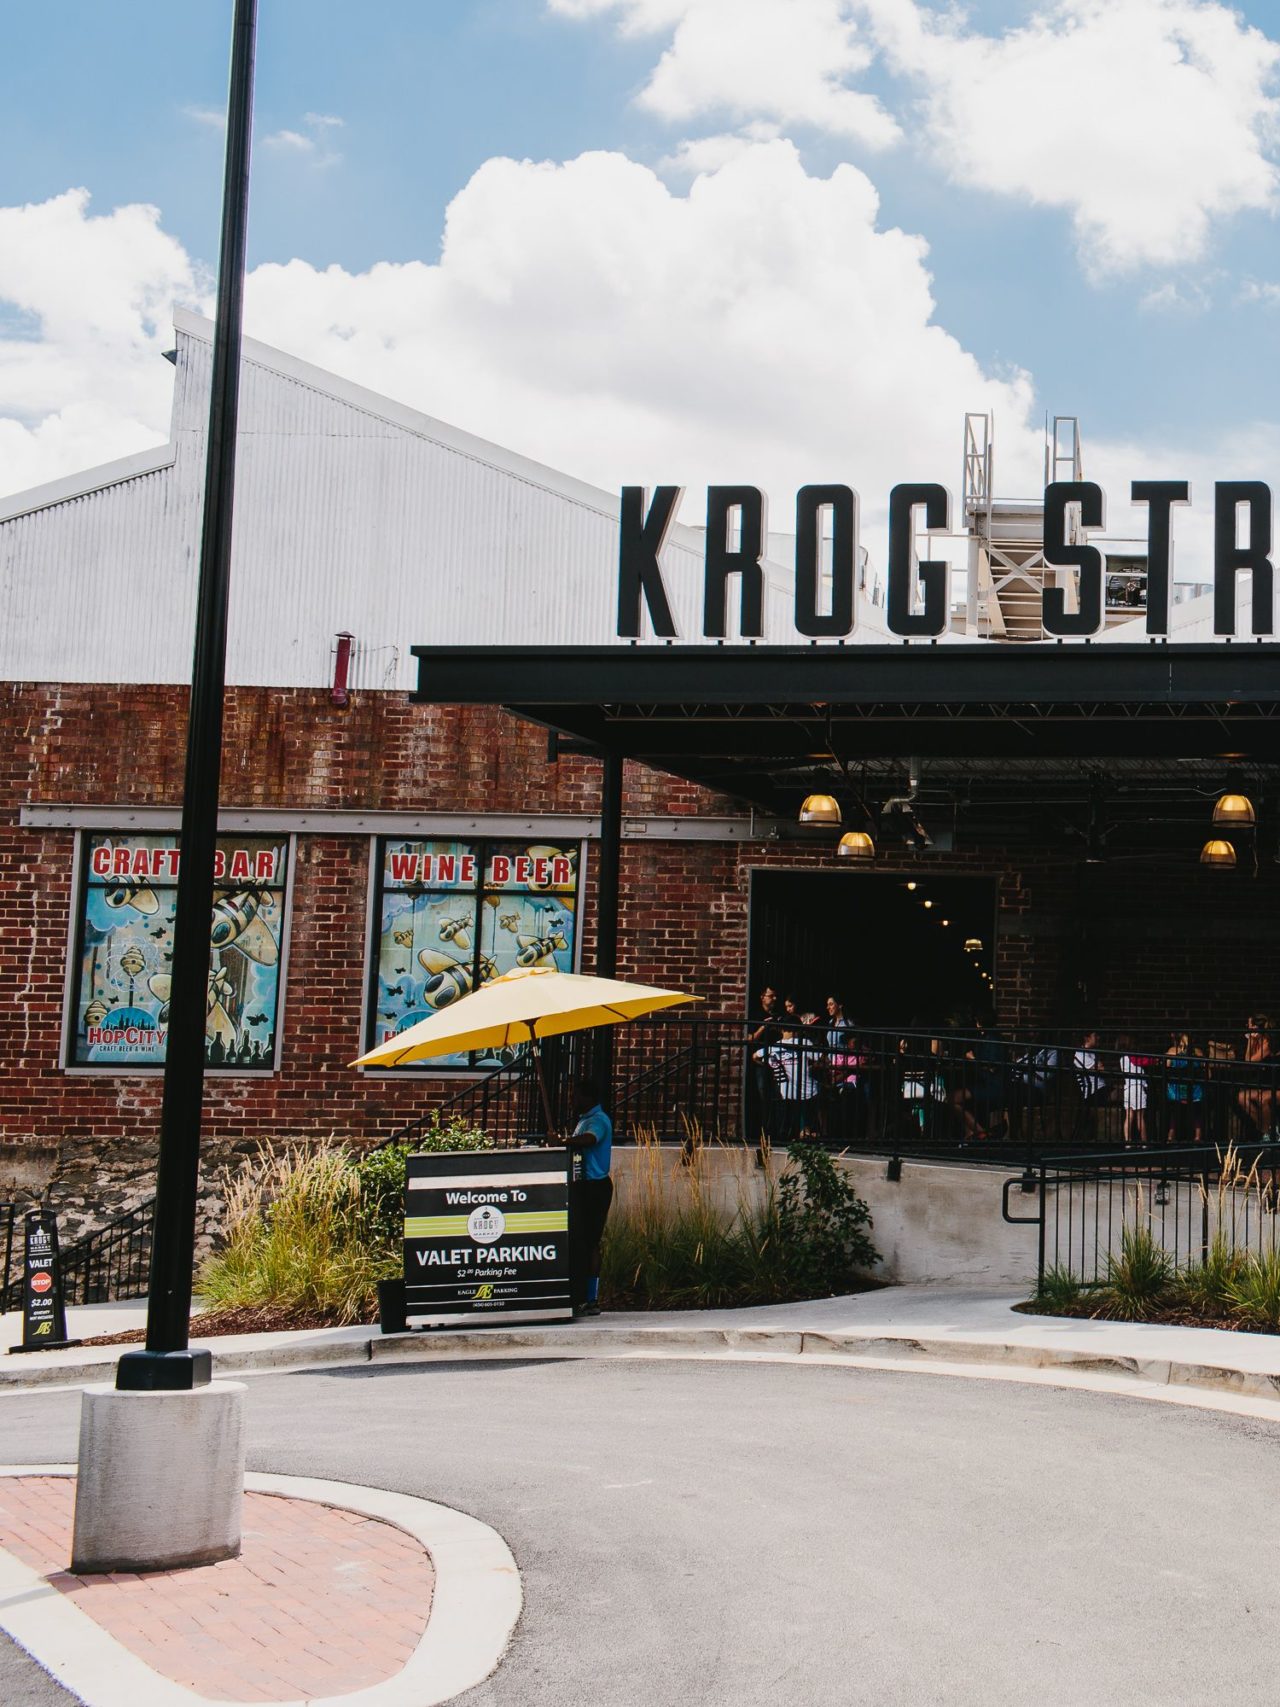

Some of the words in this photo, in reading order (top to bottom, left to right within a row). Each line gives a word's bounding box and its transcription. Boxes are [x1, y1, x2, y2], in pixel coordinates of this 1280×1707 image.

[617, 483, 952, 639] KROG
[92, 847, 181, 877] CRAFT
[391, 854, 476, 883] WINE
[492, 856, 572, 885] BEER
[141, 1045, 155, 1053] WINE
[446, 1190, 508, 1205] Welcome
[511, 1190, 527, 1201] To
[416, 1249, 472, 1266] VALET
[477, 1245, 556, 1263] PARKING
[29, 1258, 53, 1269] VALET
[475, 1268, 502, 1277] Parking
[504, 1267, 517, 1275] Fee
[31, 1299, 52, 1307] $2.00
